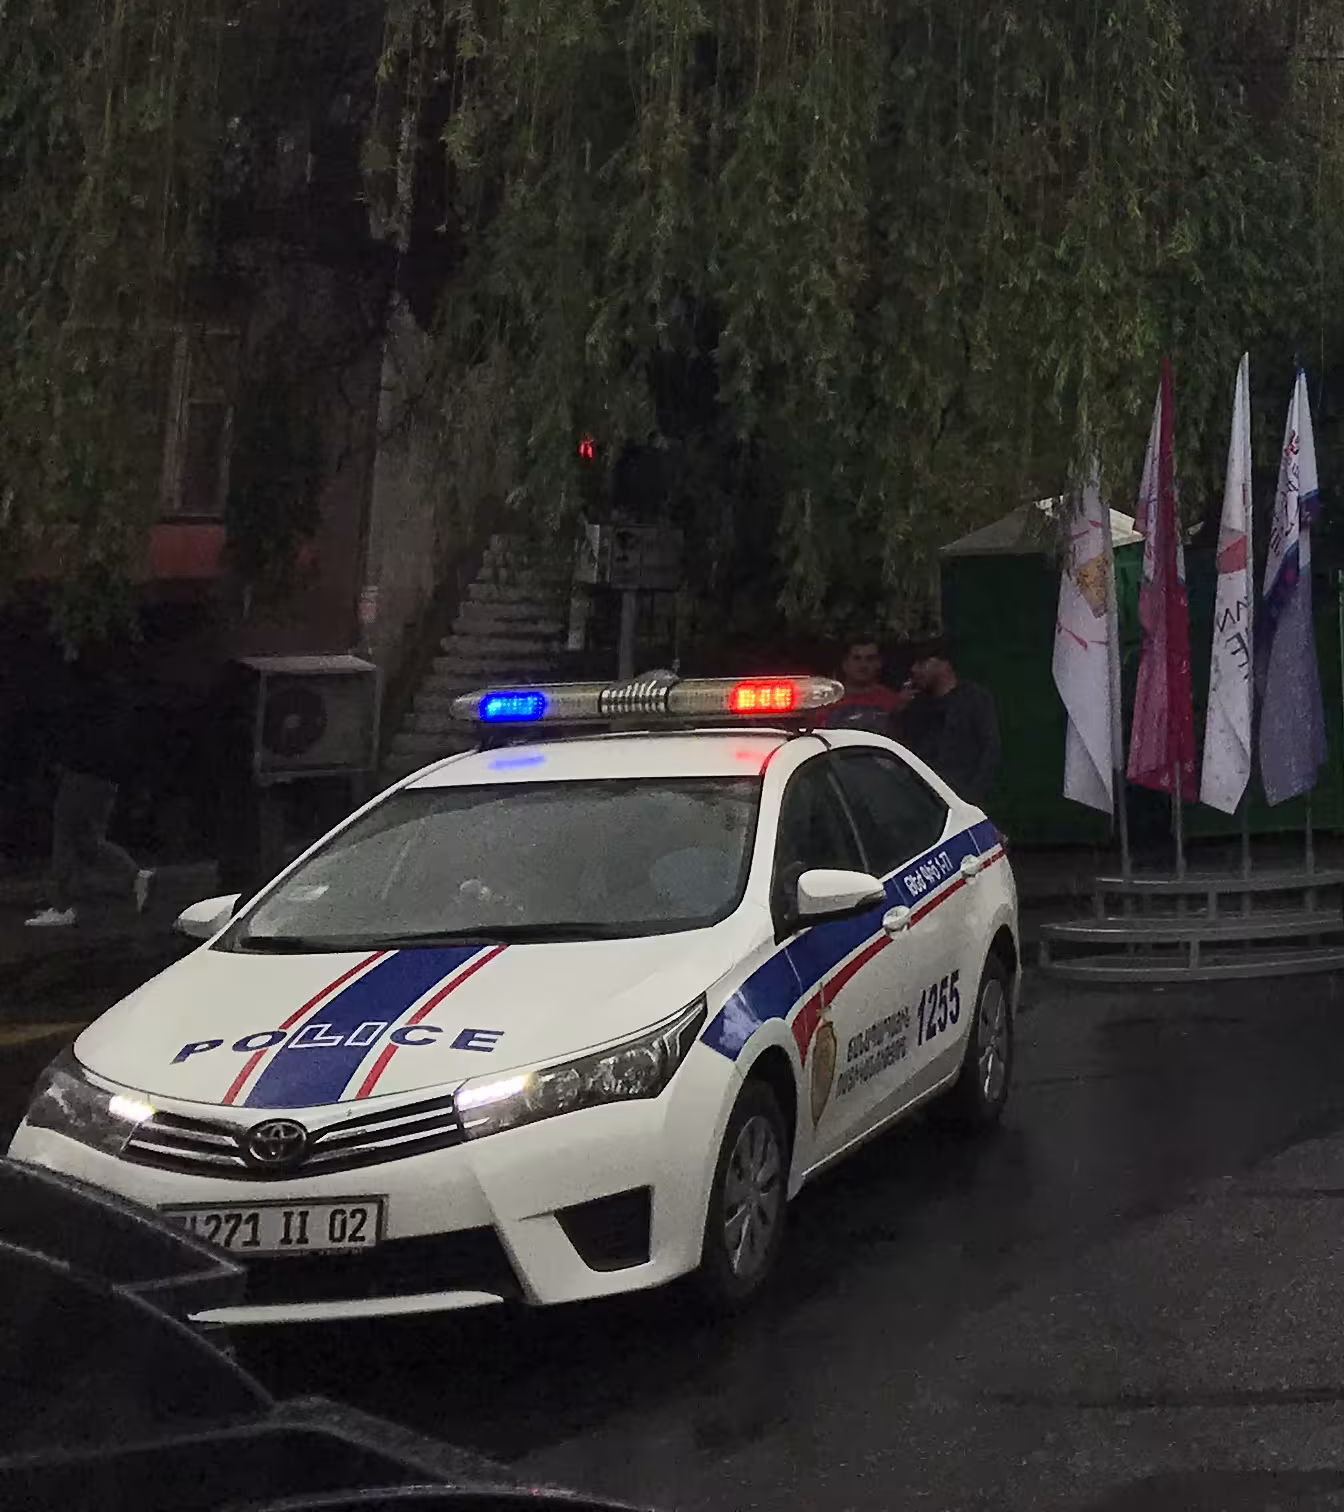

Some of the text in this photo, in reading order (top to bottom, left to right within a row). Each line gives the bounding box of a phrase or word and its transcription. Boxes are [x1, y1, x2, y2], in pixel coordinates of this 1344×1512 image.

[917, 969, 960, 1046] 1255
[170, 1022, 504, 1064] POLICE
[328, 1208, 367, 1242] 02
